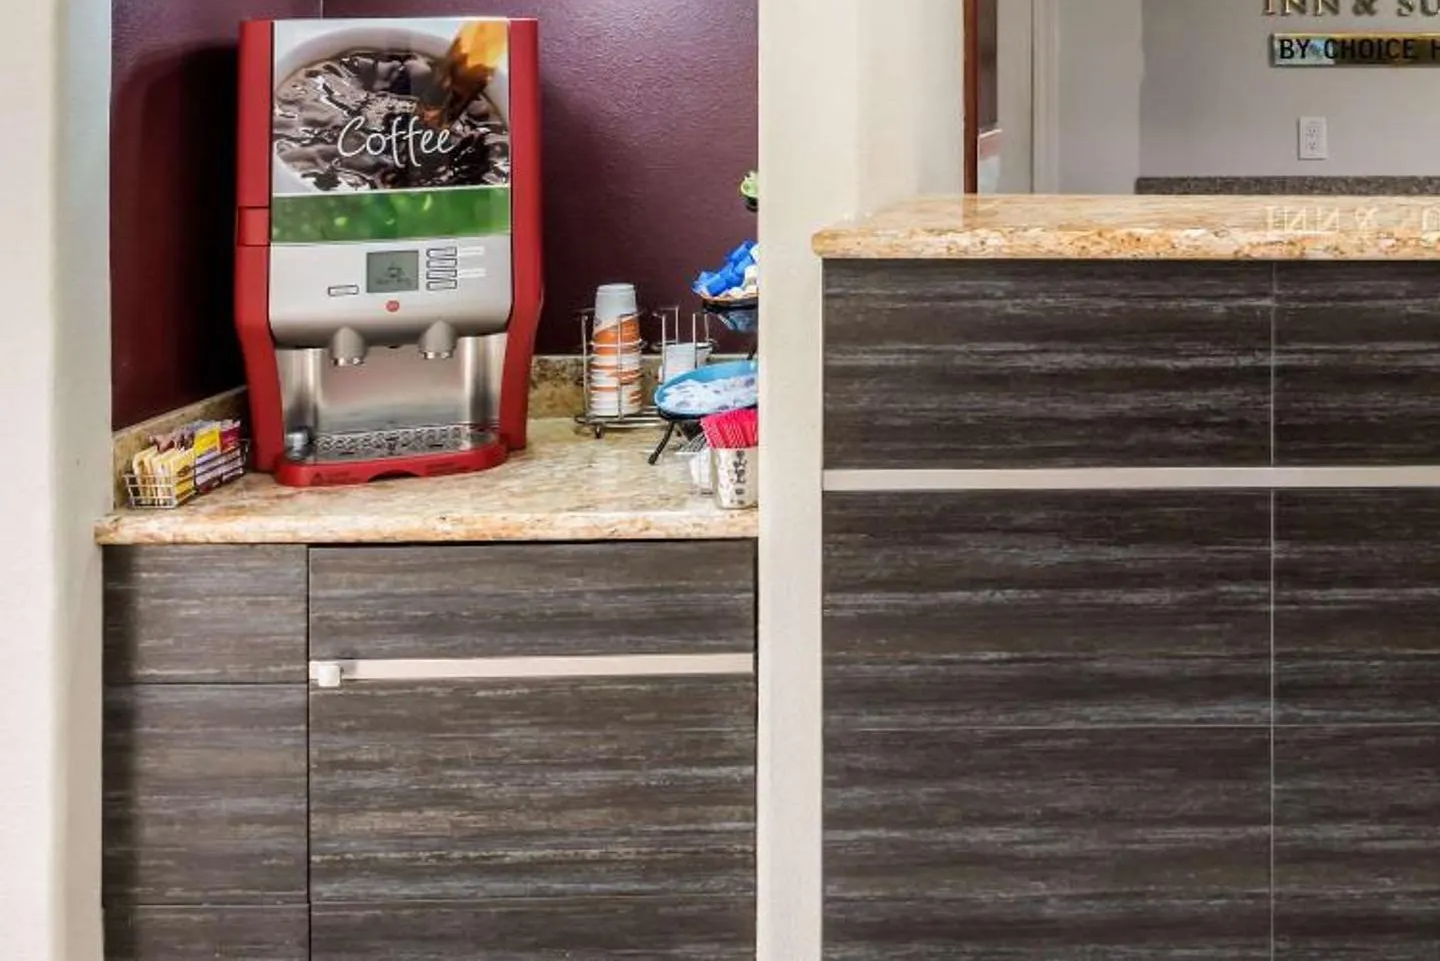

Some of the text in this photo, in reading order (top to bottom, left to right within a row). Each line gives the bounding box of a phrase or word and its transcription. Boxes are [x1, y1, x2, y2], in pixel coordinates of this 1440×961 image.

[1279, 38, 1314, 60] BY
[1323, 38, 1416, 60] CHOICE
[337, 115, 456, 168] Coffee
